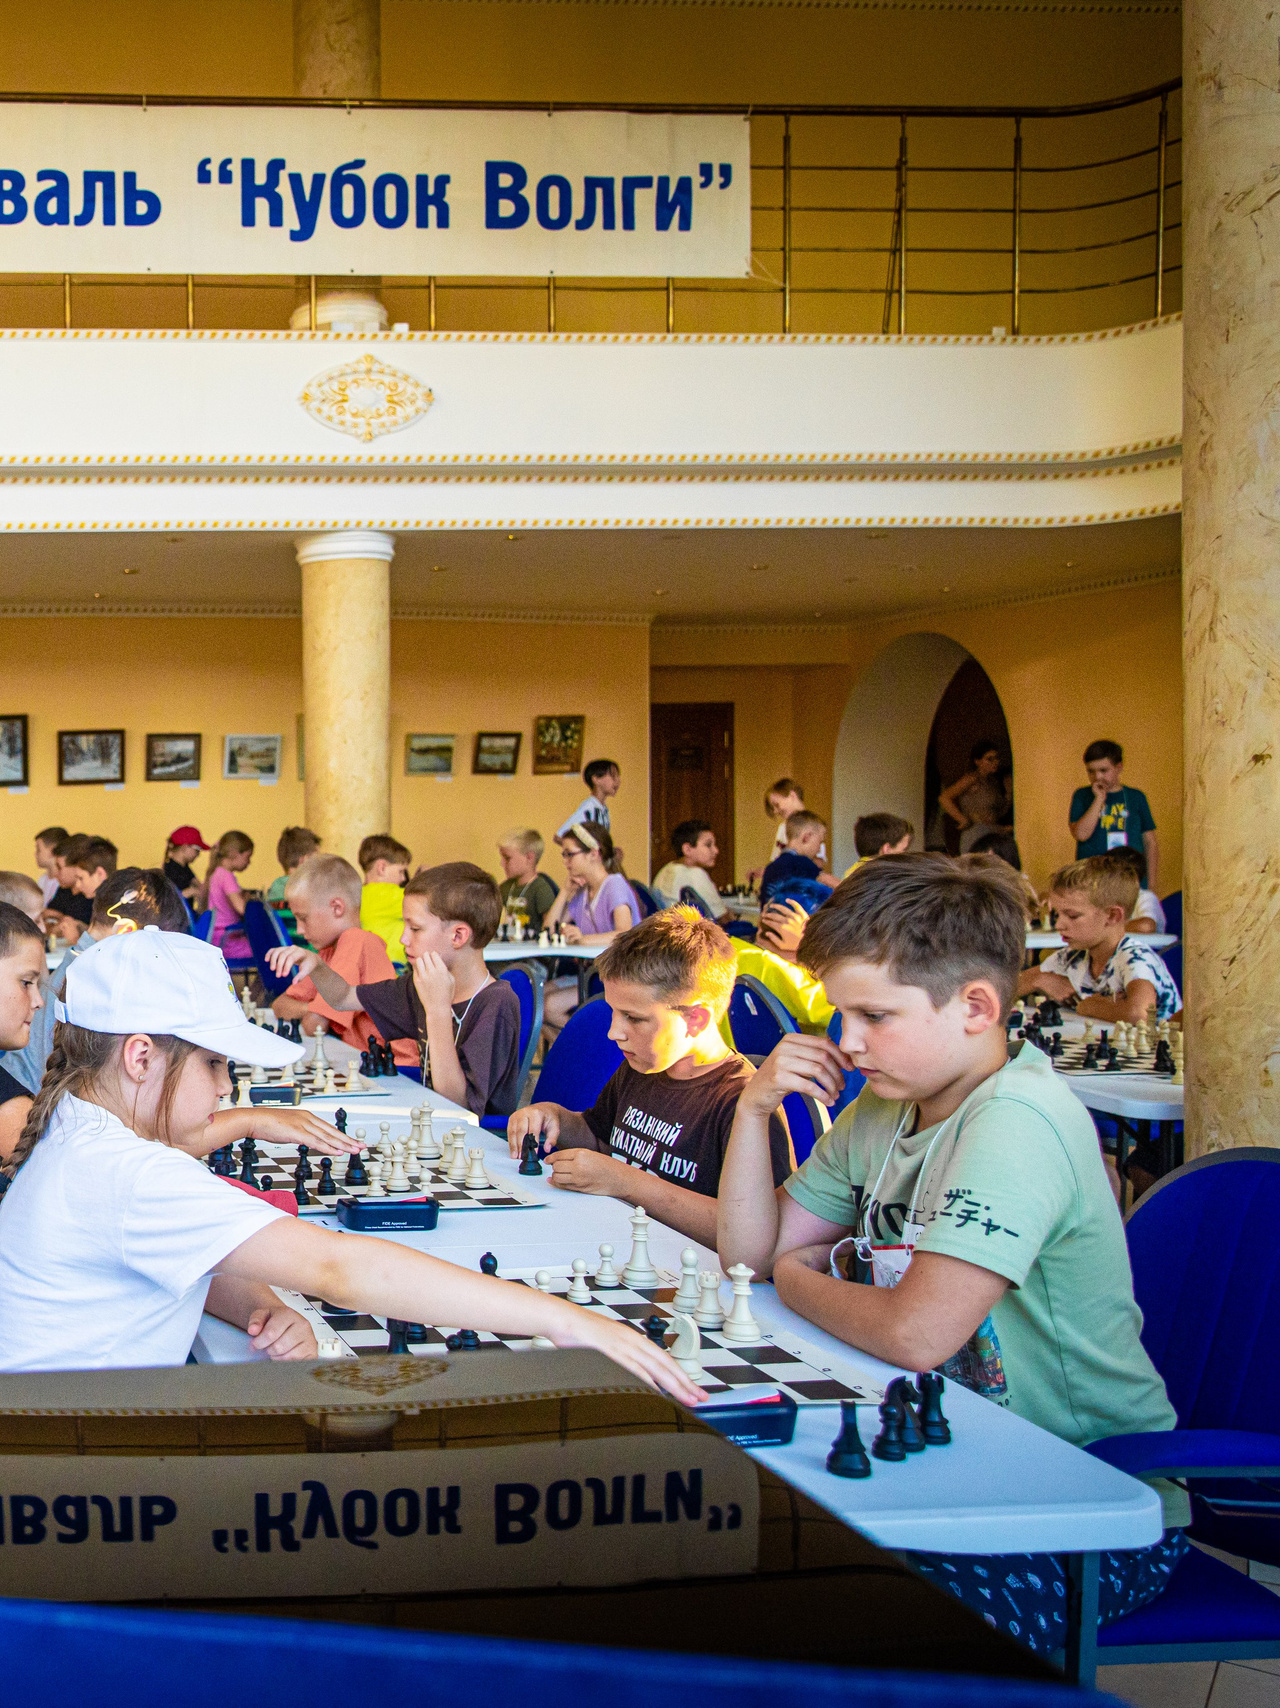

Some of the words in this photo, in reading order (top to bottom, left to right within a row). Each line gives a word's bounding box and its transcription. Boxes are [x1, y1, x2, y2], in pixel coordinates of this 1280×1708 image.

[196, 157, 451, 242] “Кубок
[484, 160, 733, 232] Волги”
[659, 1151, 699, 1183] КЛУБ
